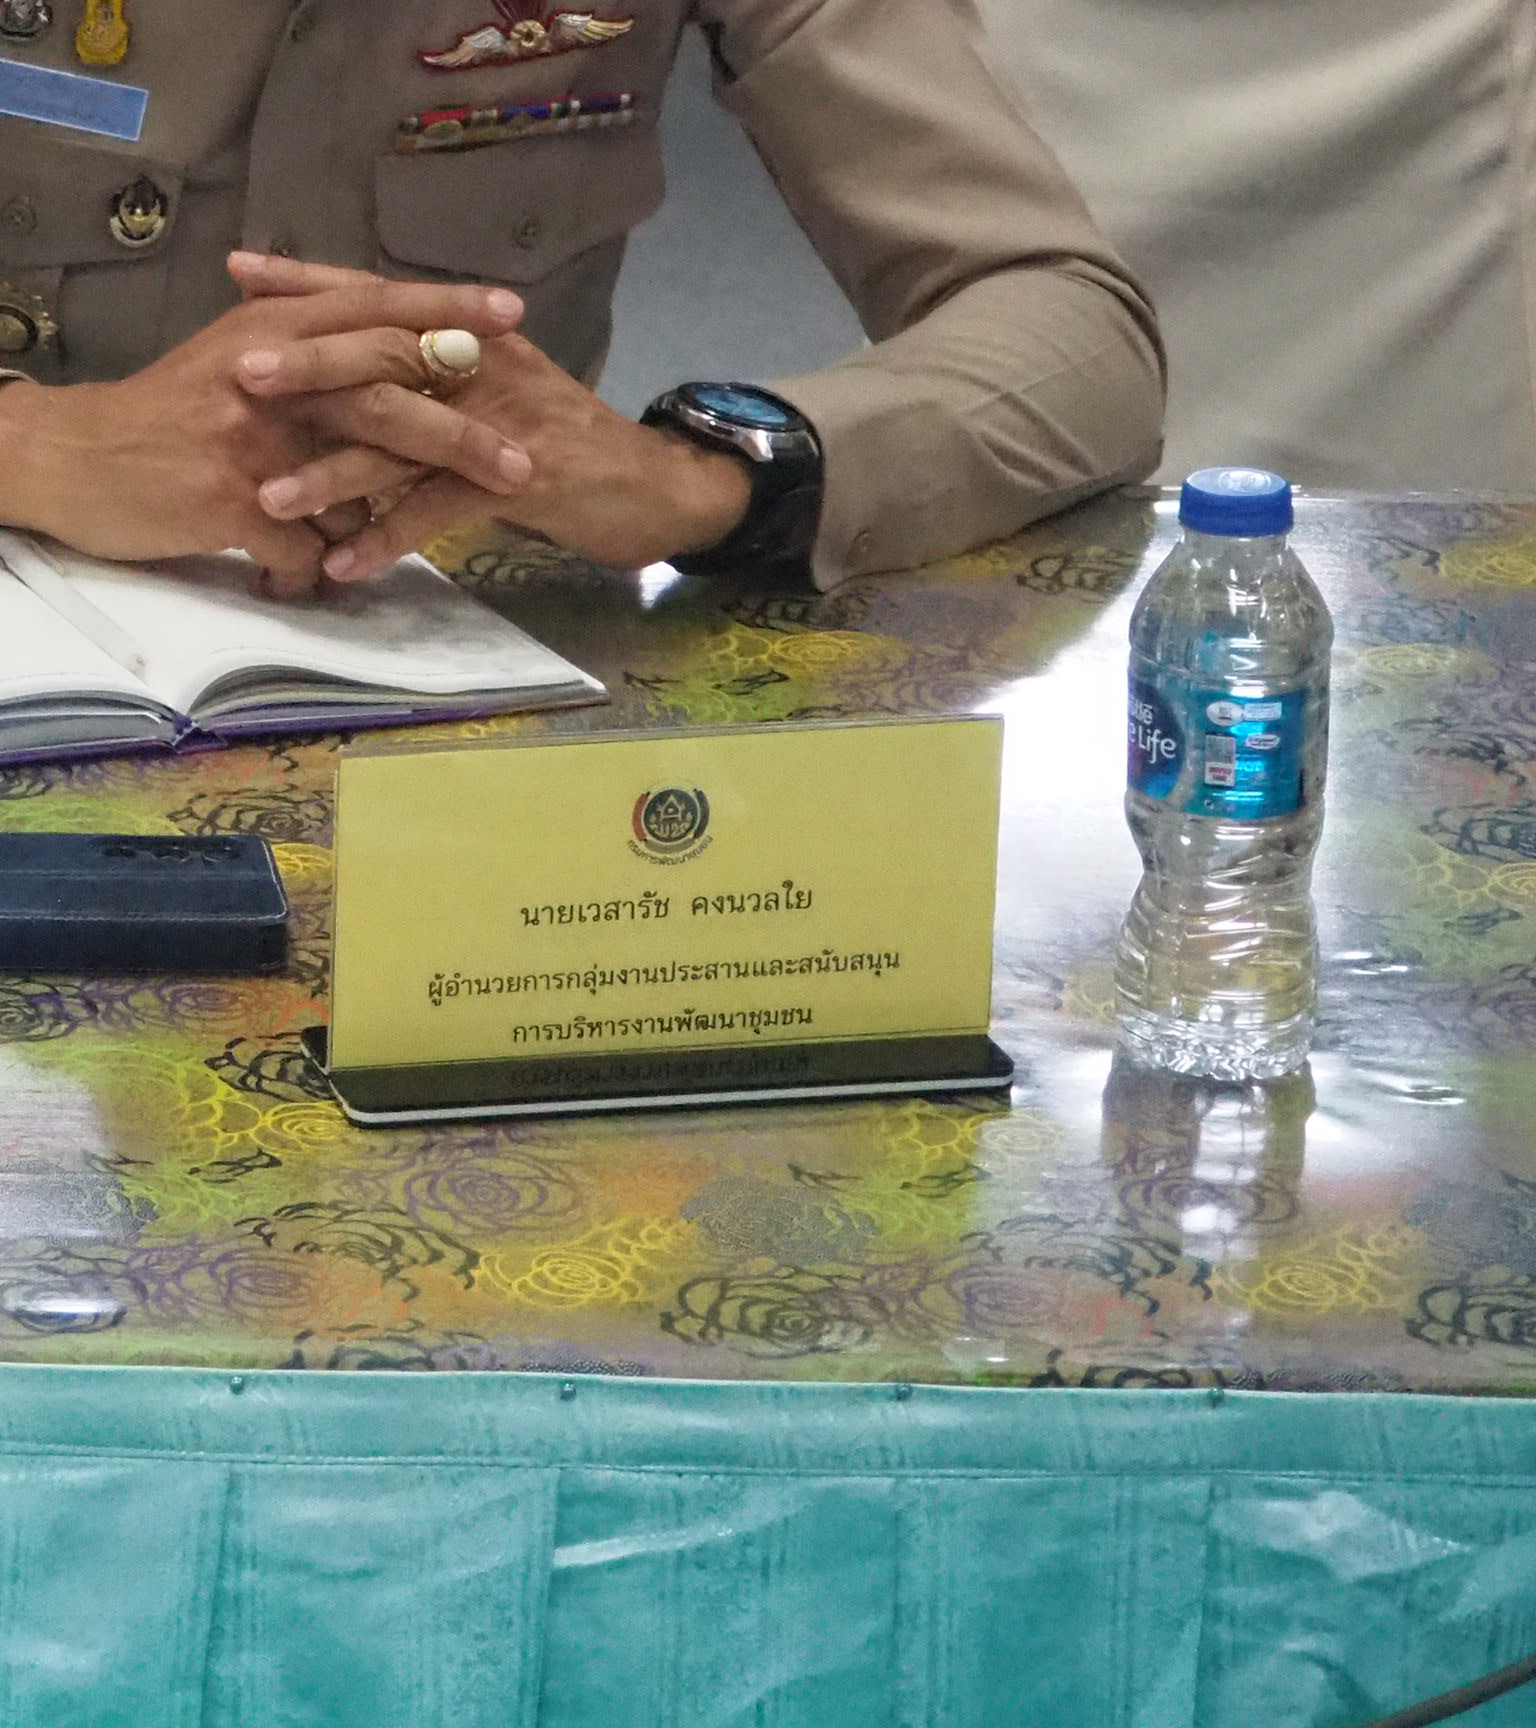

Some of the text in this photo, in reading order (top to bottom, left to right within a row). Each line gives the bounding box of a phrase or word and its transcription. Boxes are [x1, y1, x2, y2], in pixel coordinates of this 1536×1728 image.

[1138, 724, 1177, 764] Life
[519, 879, 814, 928] นายเวสารัช คงนวลใย
[427, 947, 902, 1007] ผู้อำนวยการกลุ่มงานประสานและสนับสนุน
[511, 1005, 815, 1045] การบริหารงานพัฒนาชุมชน
